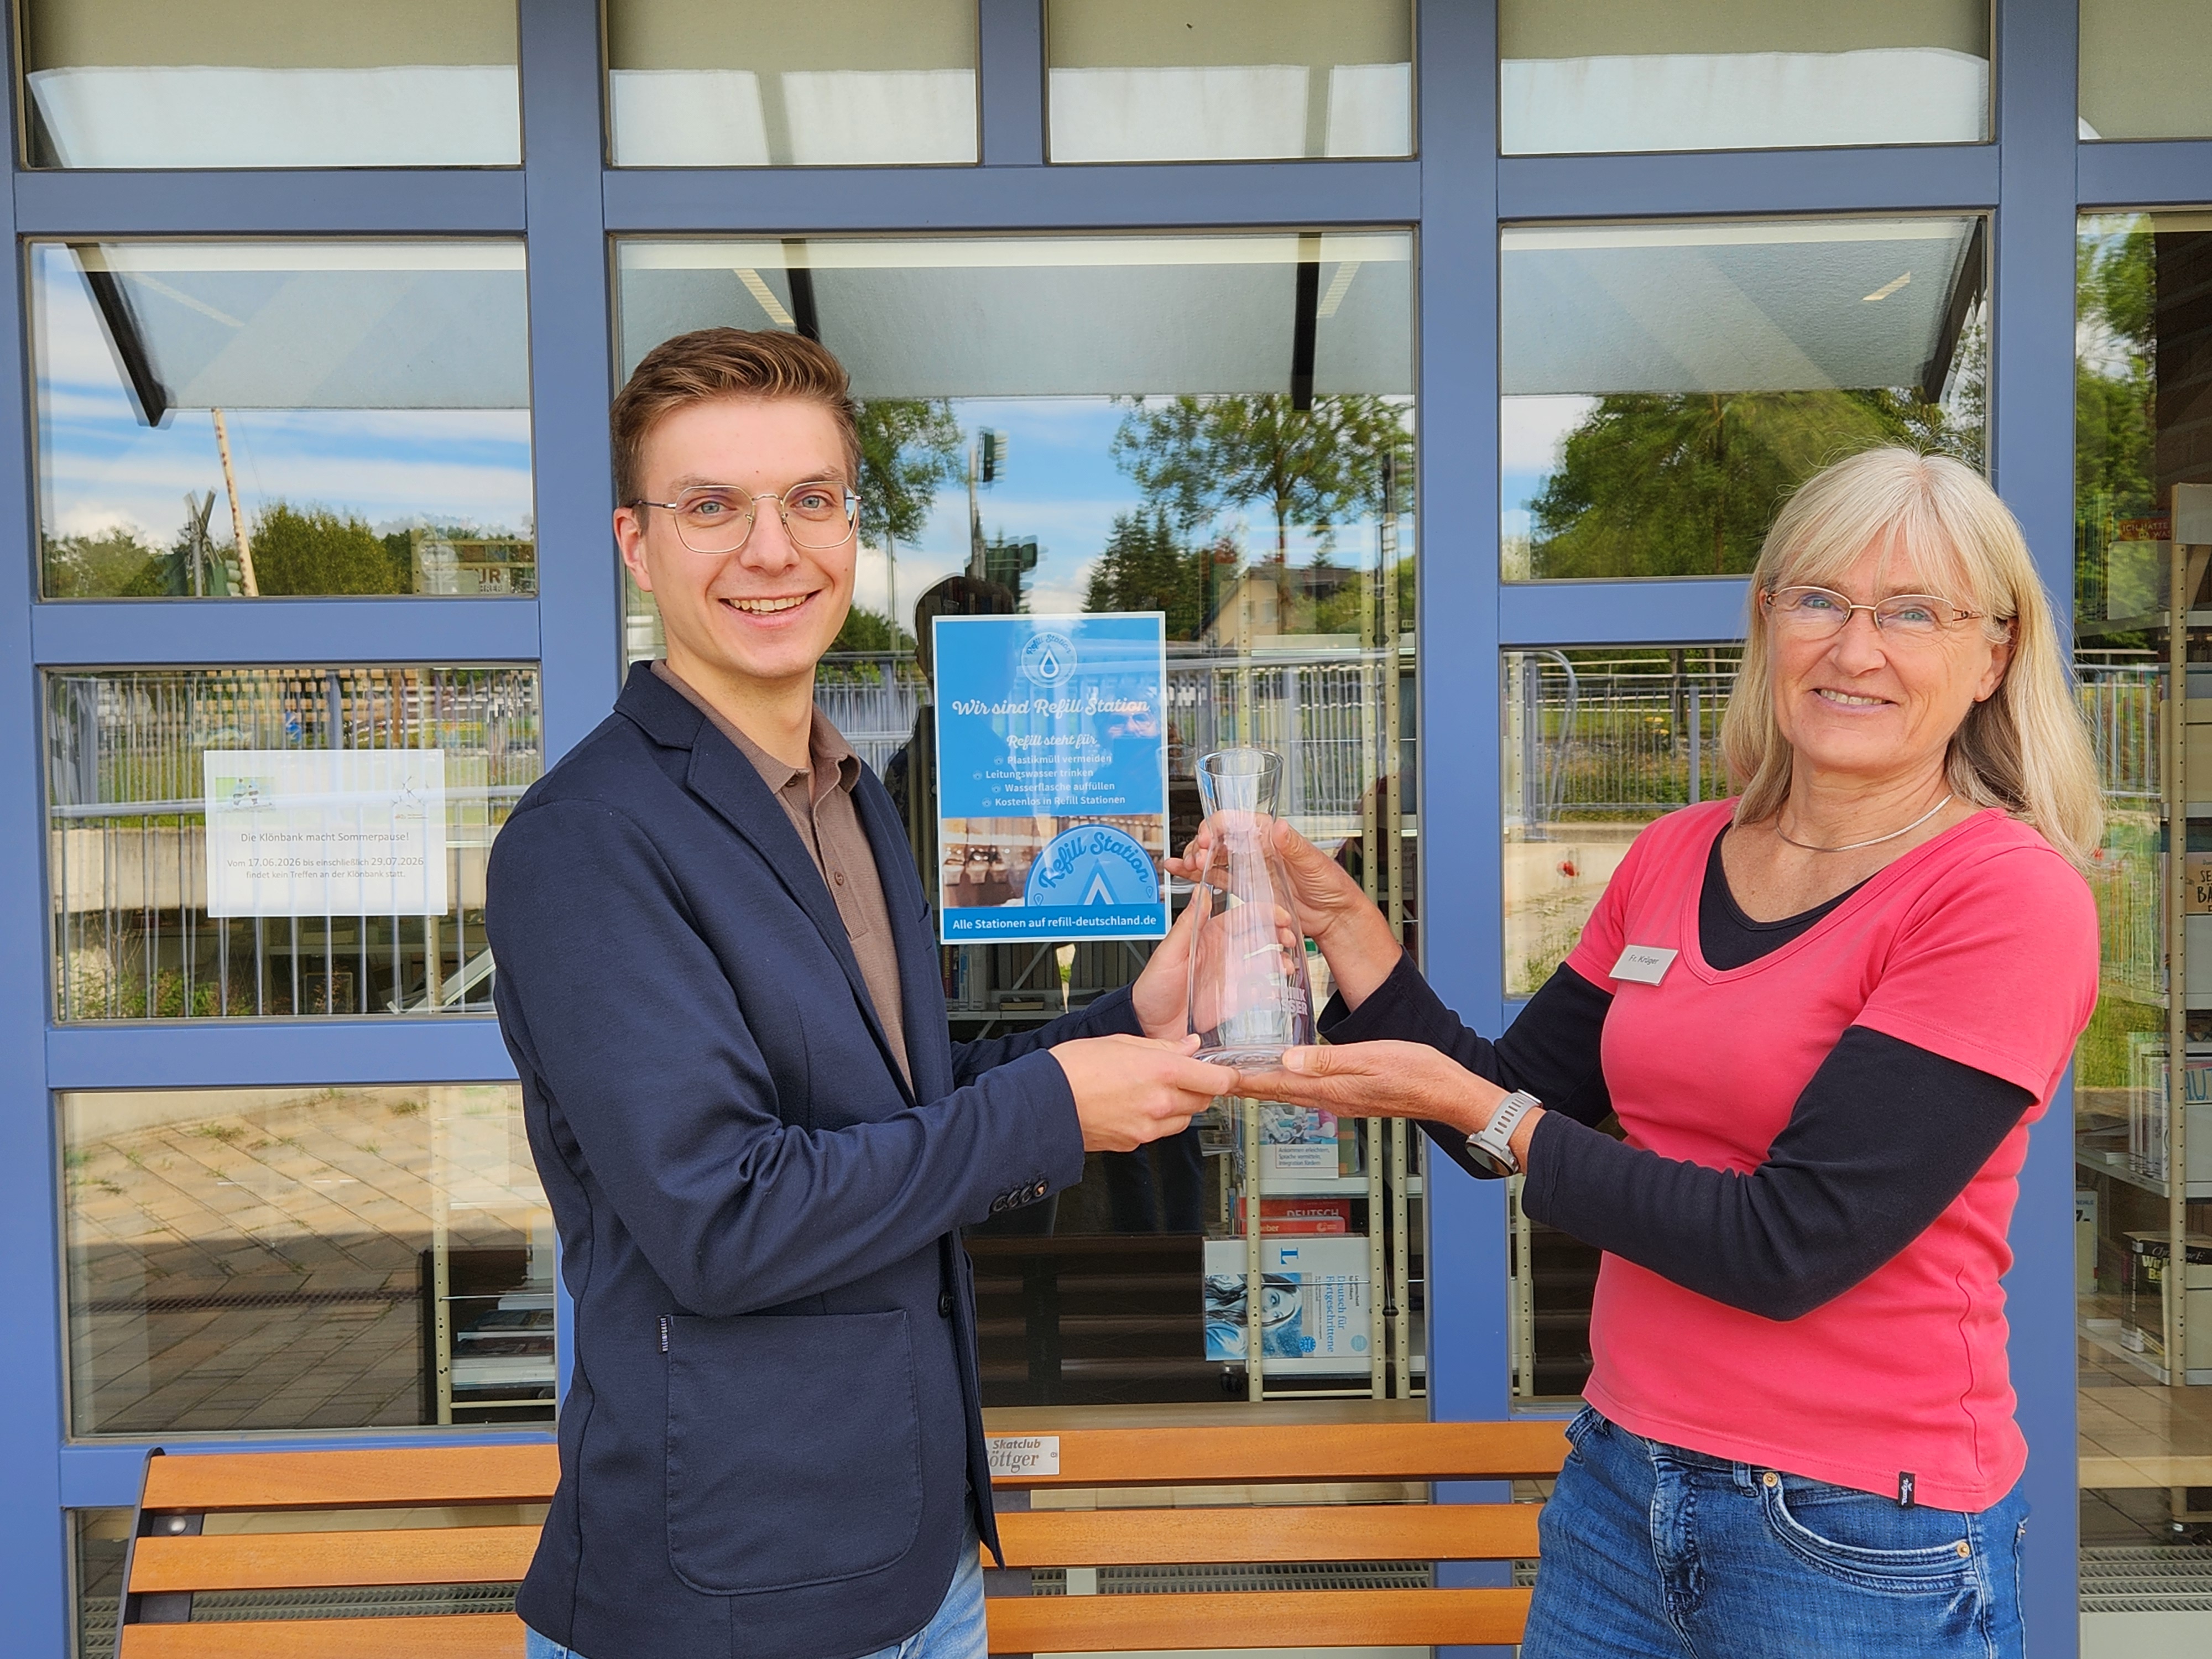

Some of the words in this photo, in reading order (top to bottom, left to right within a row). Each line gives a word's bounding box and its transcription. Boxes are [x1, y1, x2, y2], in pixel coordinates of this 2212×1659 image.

[1026, 635, 1044, 655] Refill
[1045, 634, 1072, 654] Station
[952, 699, 990, 715] Wir
[992, 700, 1029, 714] sind
[1034, 699, 1084, 719] Refill
[1085, 697, 1150, 716] Station
[1006, 735, 1044, 750] Refill
[1044, 734, 1075, 747] steht
[1076, 734, 1098, 749] für
[1007, 755, 1060, 764] Plastikmüll
[1062, 754, 1112, 763] vermeiden
[986, 770, 1058, 780] Leitungswasser
[1060, 769, 1093, 777] trinken
[1005, 783, 1071, 792] Wasserflasche
[1073, 782, 1115, 791] auffüllen
[995, 797, 1041, 806] Kostenlos
[1043, 797, 1052, 805] in
[1054, 796, 1078, 805] Refill
[1081, 795, 1125, 804] Stationen
[241, 833, 257, 842] Die
[259, 832, 303, 842] Klönbank
[306, 833, 335, 841] macht
[338, 832, 409, 843] Sommerpause!
[248, 858, 301, 867] 17.06.2026
[316, 858, 369, 867] einschließlich
[371, 857, 424, 866] 29.07.2026
[1038, 836, 1087, 889] Refill
[1090, 832, 1150, 883] Station
[247, 870, 270, 879] findet
[953, 919, 973, 930] Alle
[975, 918, 1026, 929] Stationen
[1028, 917, 1046, 928] auf
[1047, 915, 1157, 927] refill-deutschland.de
[1637, 956, 1659, 965] Krüger
[1287, 1208, 1339, 1217] DEUTSCH
[1280, 1247, 1298, 1265] L
[1337, 1276, 1347, 1313] Deutsch
[1338, 1316, 1348, 1329] für
[993, 1439, 1041, 1449] Skatclub
[988, 1451, 1040, 1473] öttger
